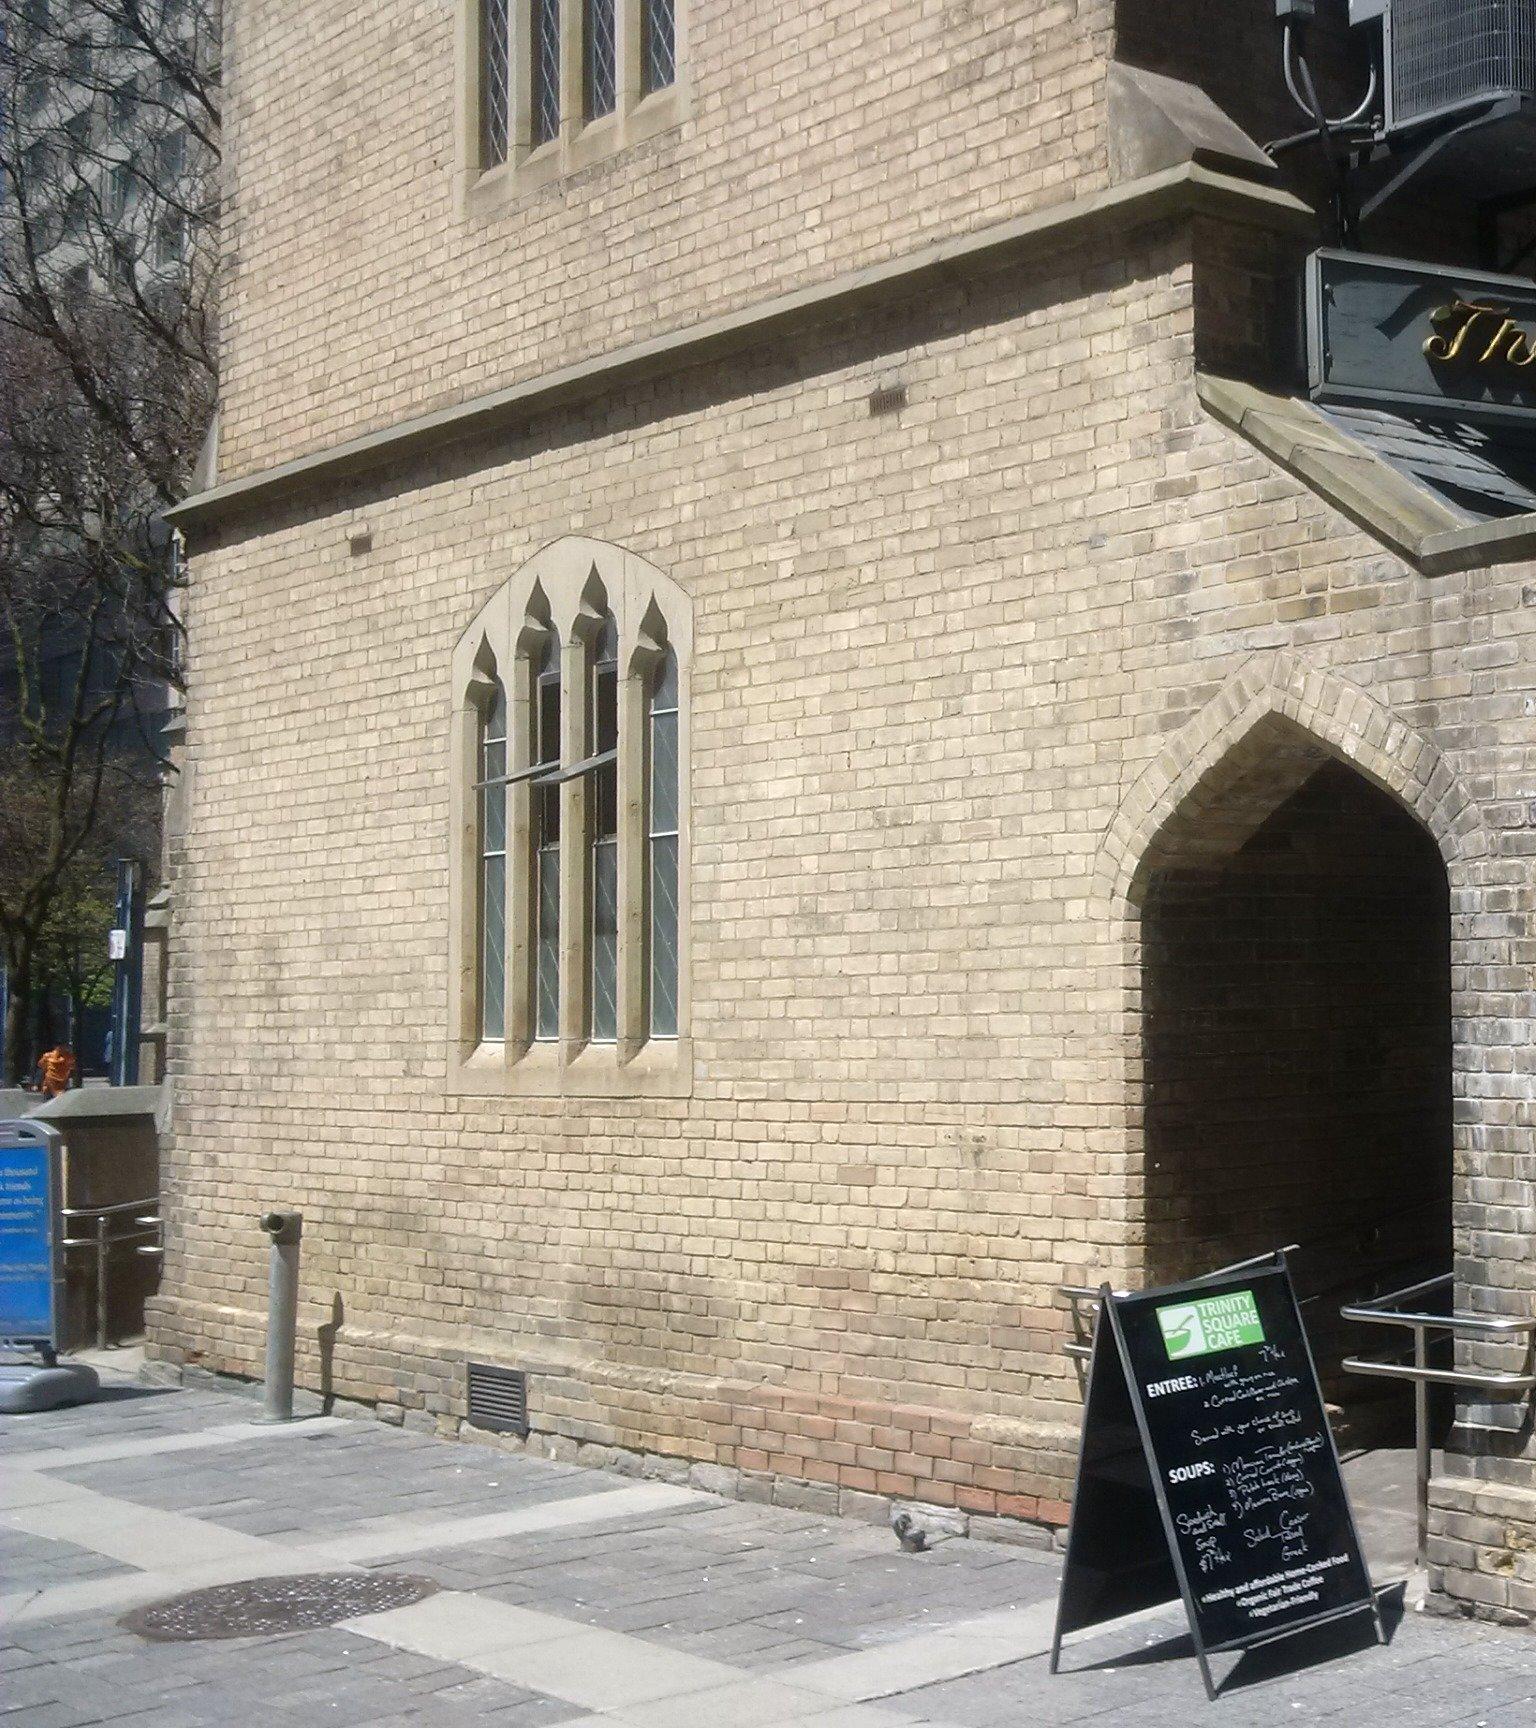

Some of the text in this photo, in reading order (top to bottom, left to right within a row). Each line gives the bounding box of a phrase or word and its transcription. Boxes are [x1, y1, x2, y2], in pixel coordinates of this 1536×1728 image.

[1198, 1296, 1251, 1317] TRINITY
[1203, 1310, 1260, 1334] SQUARE
[1207, 1329, 1243, 1349] CAFE
[1146, 1375, 1199, 1398] ENTREE:
[1168, 1460, 1216, 1484] SOUPS:
